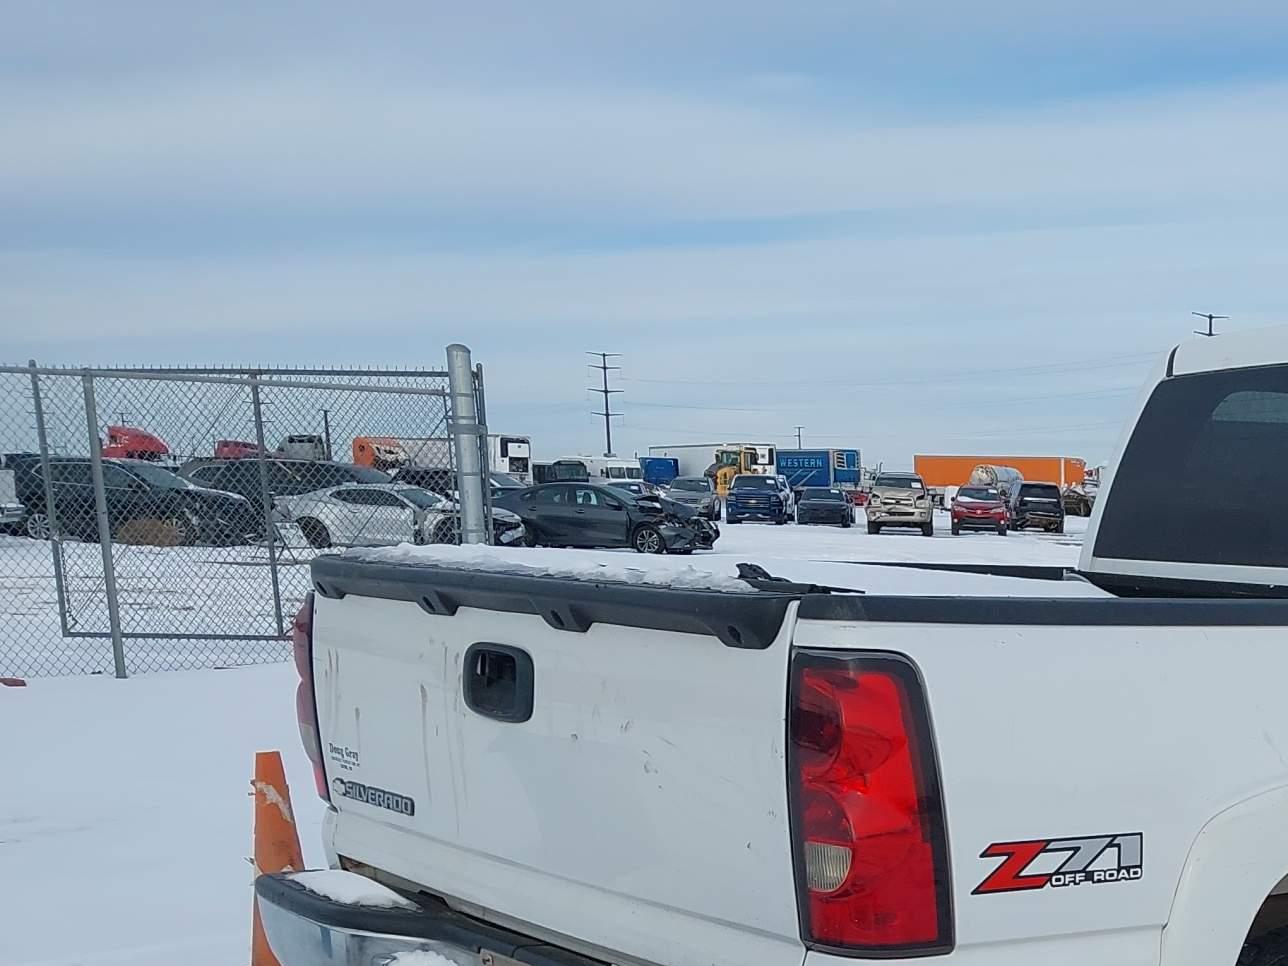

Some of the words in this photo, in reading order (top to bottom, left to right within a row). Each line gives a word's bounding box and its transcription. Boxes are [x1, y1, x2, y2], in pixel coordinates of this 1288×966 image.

[779, 458, 823, 468] WESTERN
[345, 782, 412, 815] SILVERADO
[970, 832, 1143, 895] Z71
[1051, 873, 1086, 887] OFF
[1093, 868, 1142, 883] ROAD
